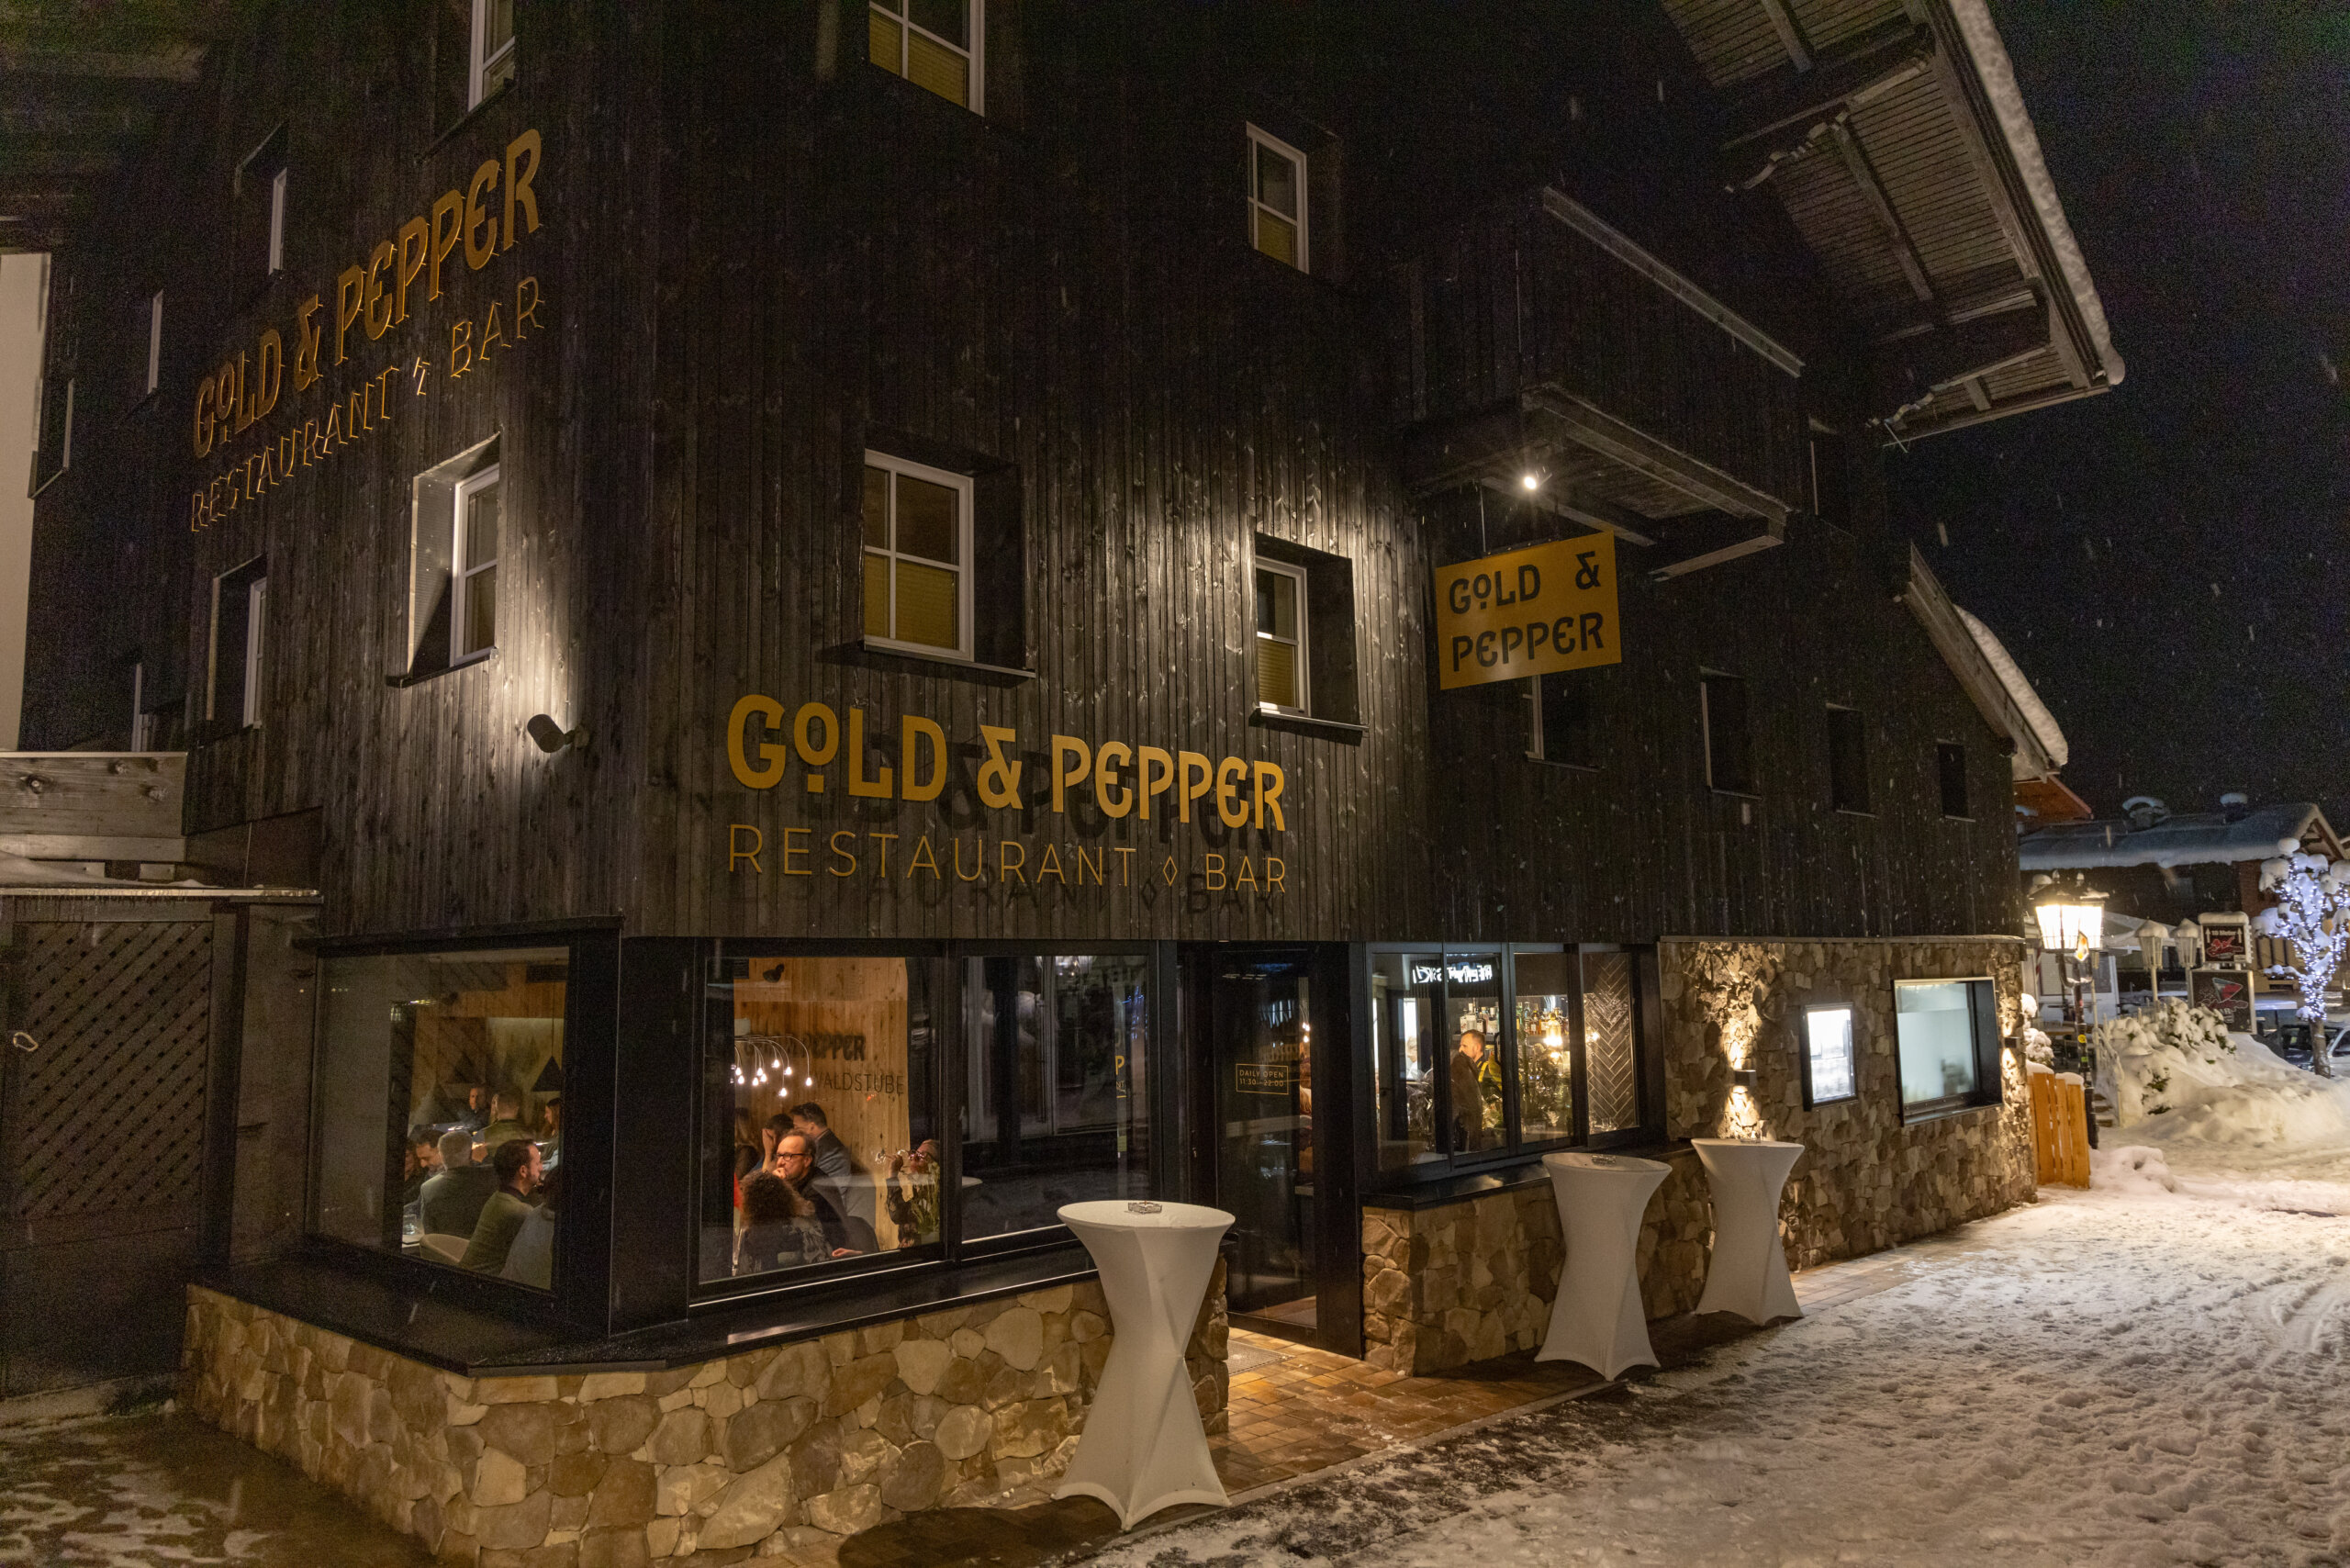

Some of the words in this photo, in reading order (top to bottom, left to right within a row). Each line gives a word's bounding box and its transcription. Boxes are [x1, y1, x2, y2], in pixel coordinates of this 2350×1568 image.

[193, 329, 284, 459] GOLD
[294, 294, 323, 392] &
[335, 129, 543, 366] PEPPER
[191, 366, 399, 532] RESTAURANT
[451, 276, 544, 378] BAR
[1449, 564, 1541, 614] GOLD
[1574, 551, 1601, 590] &
[1451, 611, 1604, 672] PEPPER
[727, 694, 947, 801] GOLD
[977, 724, 1024, 810] &
[1052, 734, 1286, 831] PEPPER
[728, 824, 1136, 888] RESTAURANT
[1205, 854, 1285, 893] BAR
